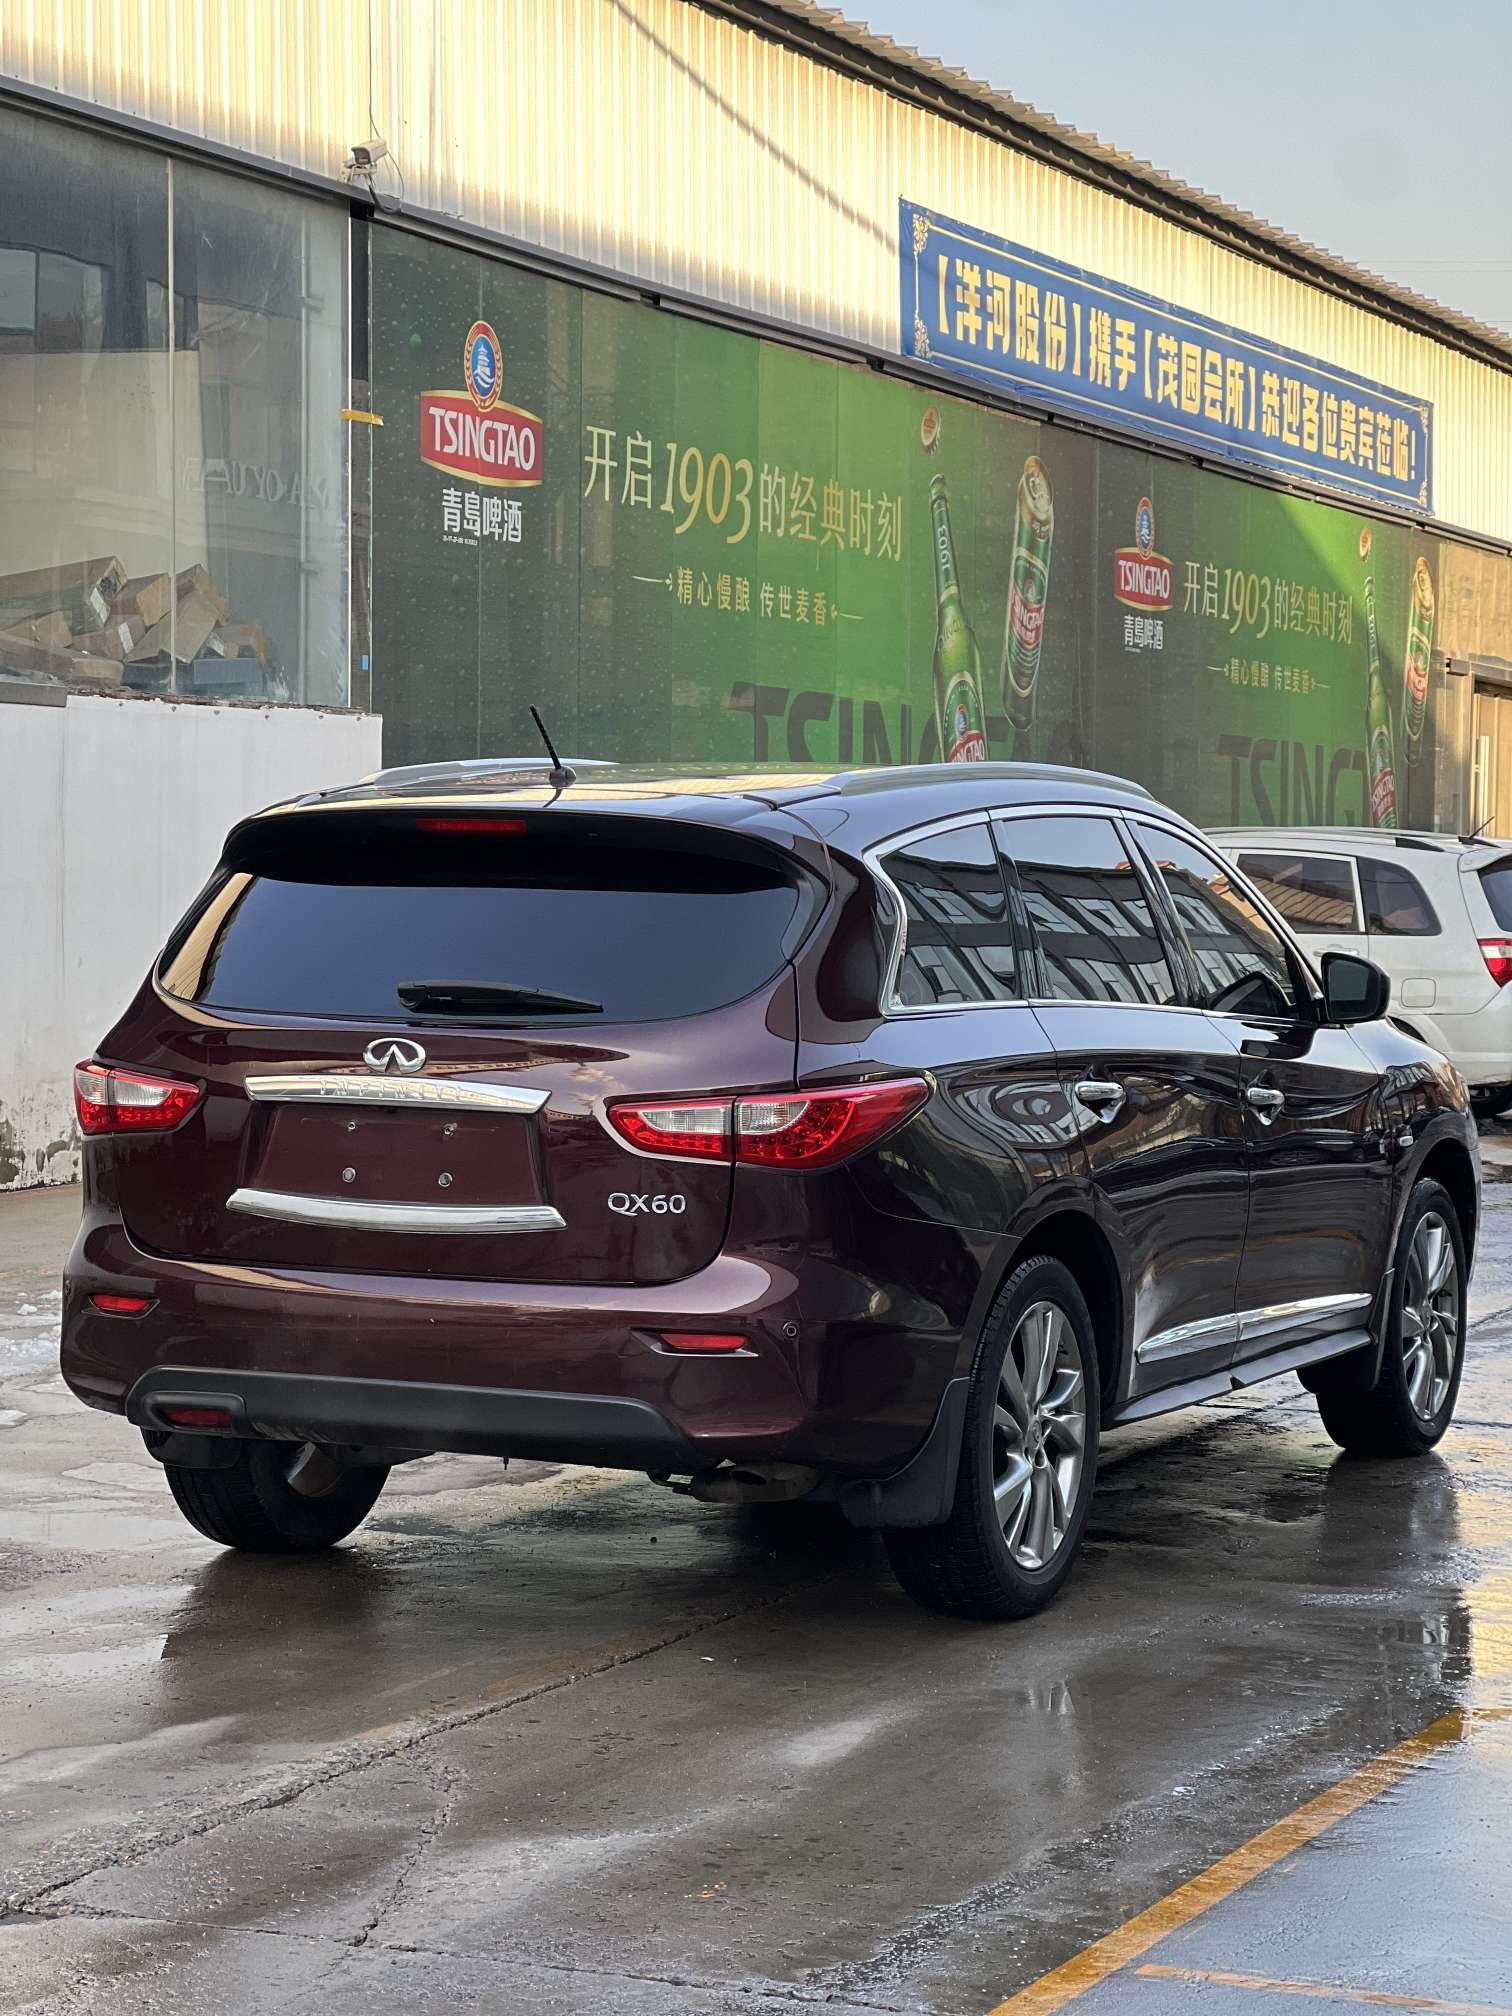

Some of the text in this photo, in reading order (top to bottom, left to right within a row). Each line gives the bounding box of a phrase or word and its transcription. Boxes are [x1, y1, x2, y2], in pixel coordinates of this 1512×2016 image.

[428, 406, 536, 471] TSINGTAO
[441, 487, 523, 543] 青岛啤酒
[584, 425, 902, 561] 开启1903的经典时刻
[677, 566, 827, 627] 精心慢酿 传世麦香
[1118, 559, 1171, 600] TSINGTAO
[1184, 561, 1353, 645] 开启1903的经典时刻
[1123, 614, 1164, 650] 青岛啤酒
[607, 1192, 686, 1217] QX60
